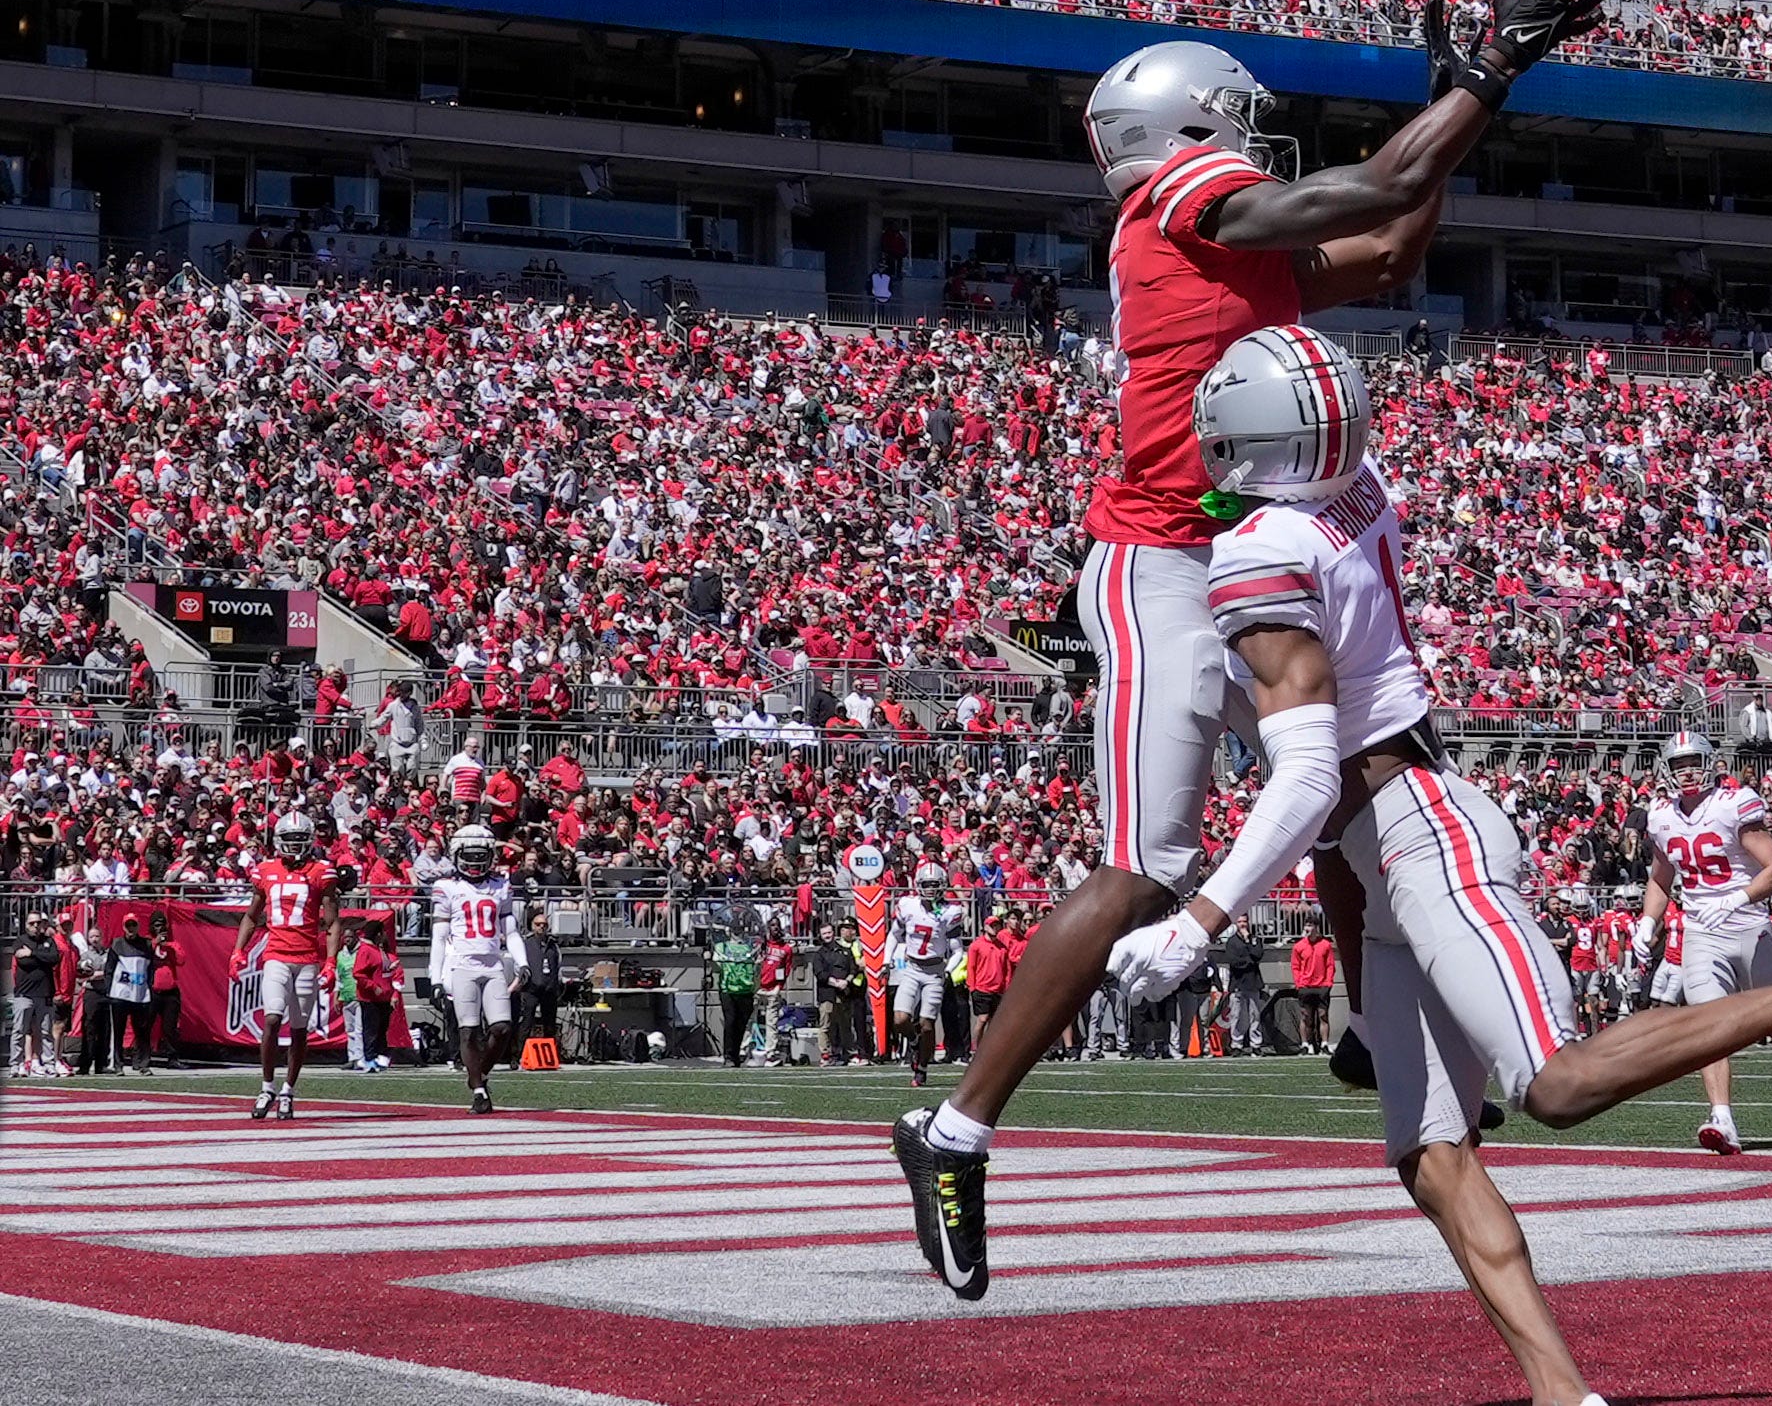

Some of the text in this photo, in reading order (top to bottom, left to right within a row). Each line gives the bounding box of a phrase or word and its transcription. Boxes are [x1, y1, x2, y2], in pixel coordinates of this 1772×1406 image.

[208, 600, 274, 617] TOYOTA
[288, 611, 316, 629] 23A
[1041, 634, 1064, 652] i'm
[1666, 831, 1733, 890] 36
[269, 883, 309, 926] 17
[461, 899, 497, 939] 10
[914, 925, 933, 956] 7
[1577, 927, 1593, 951] 9
[532, 1042, 555, 1068] 10
